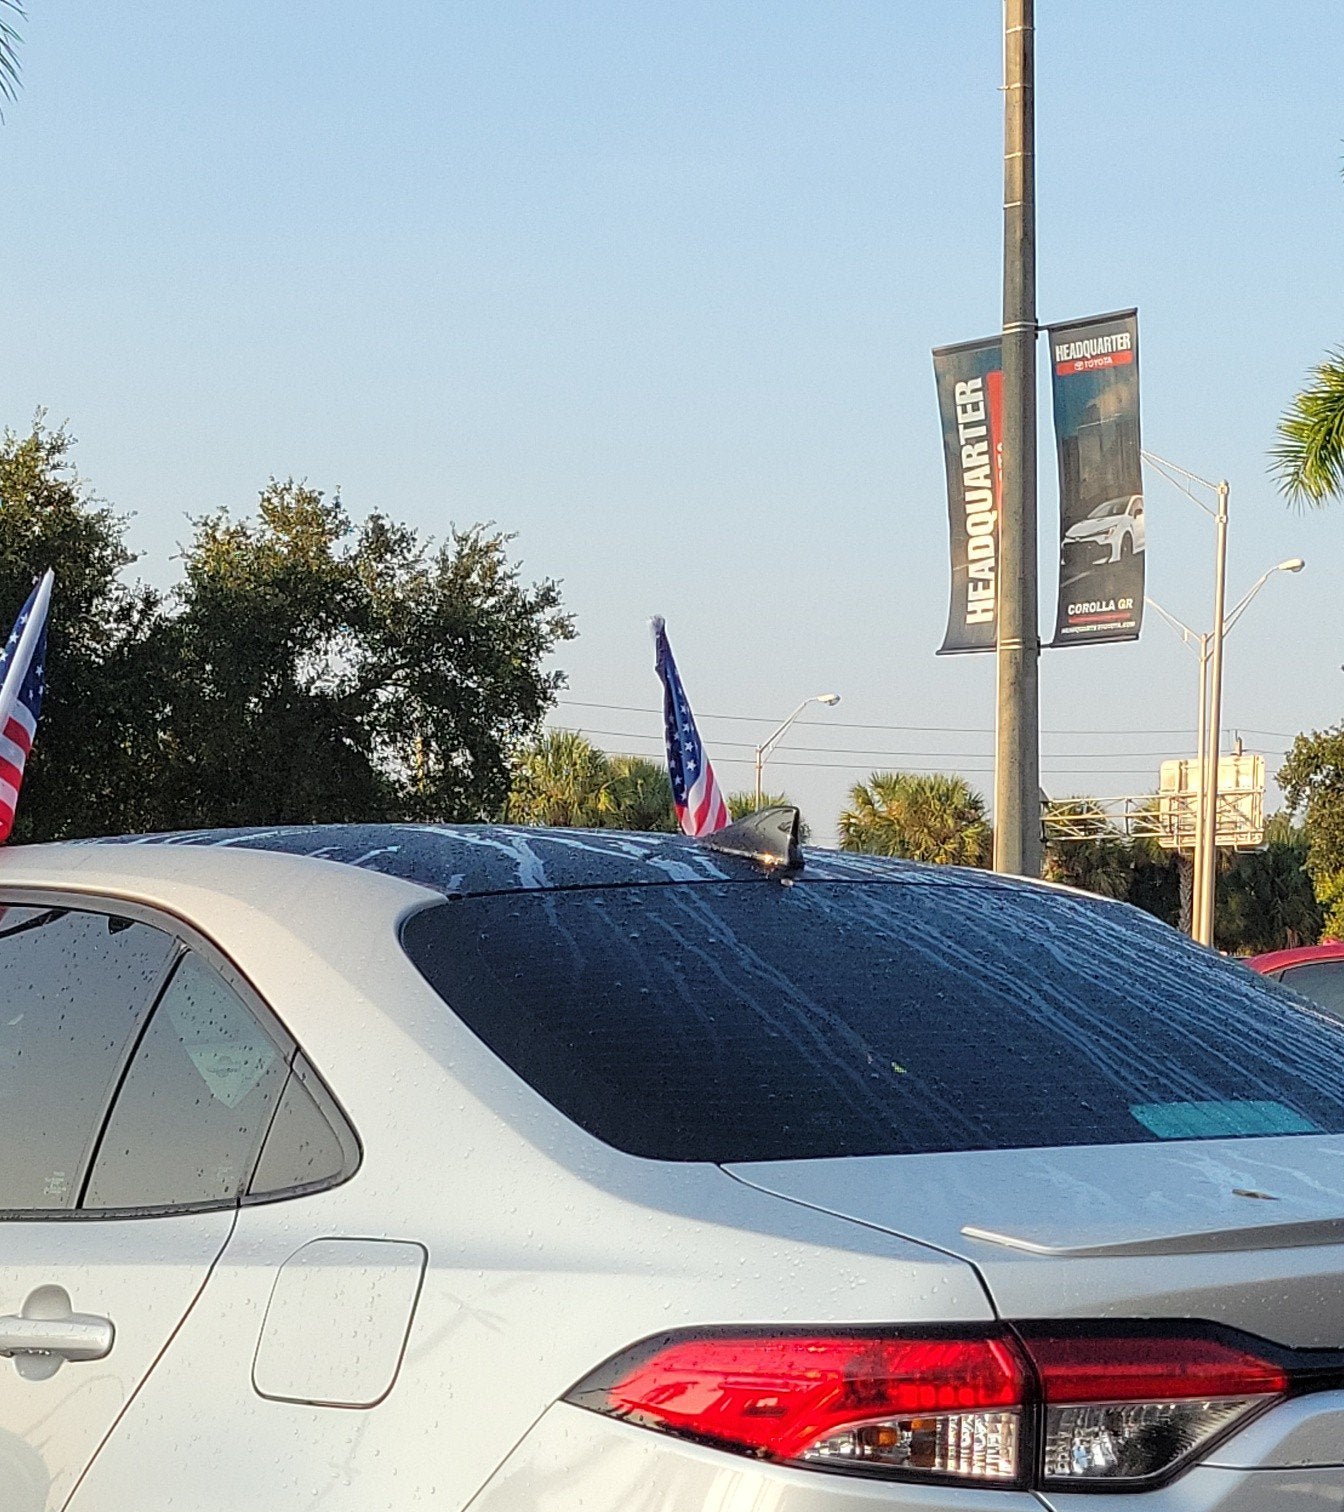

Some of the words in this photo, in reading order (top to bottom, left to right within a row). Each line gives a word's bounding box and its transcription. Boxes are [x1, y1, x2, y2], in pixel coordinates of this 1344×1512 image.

[1056, 332, 1131, 362] HEADQUARTER
[1085, 356, 1113, 368] TOYOTA
[955, 376, 997, 624] HEADQUARTER
[1068, 600, 1115, 615] COROLLA
[1117, 598, 1133, 610] GR
